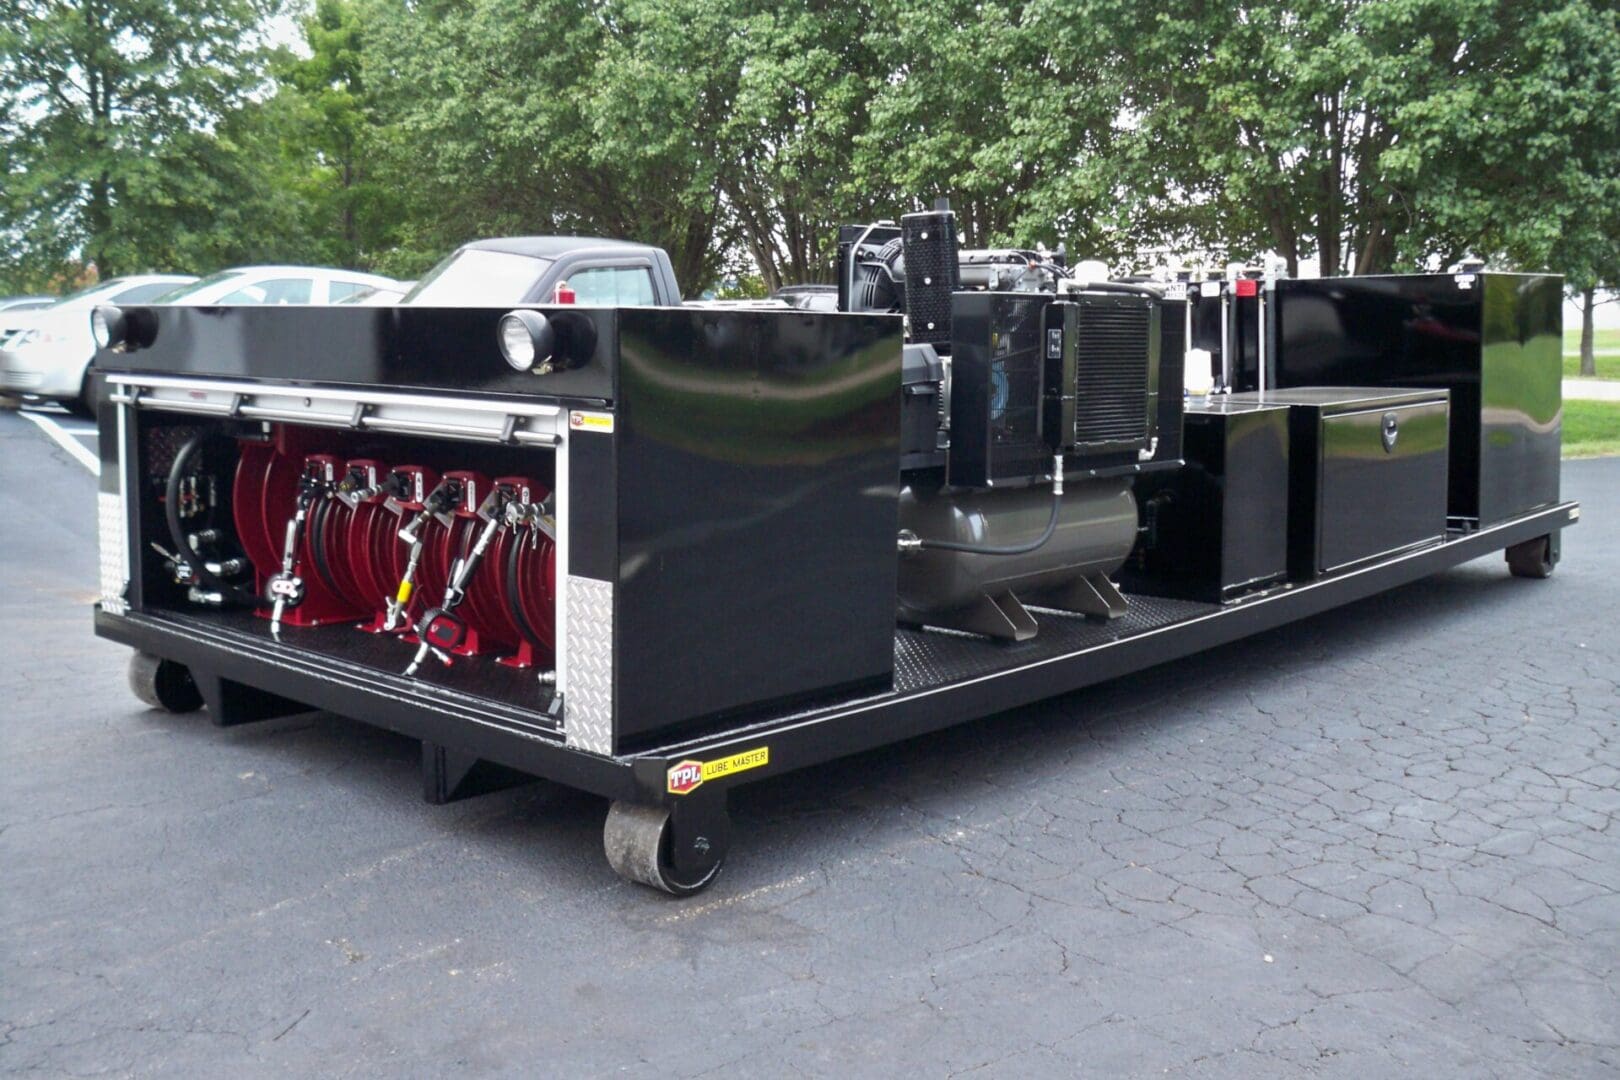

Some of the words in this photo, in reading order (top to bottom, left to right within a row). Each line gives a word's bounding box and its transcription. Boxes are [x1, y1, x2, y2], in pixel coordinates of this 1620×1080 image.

[671, 766, 700, 788] TPL
[706, 761, 728, 775] LUBE
[732, 751, 766, 769] MASTER
